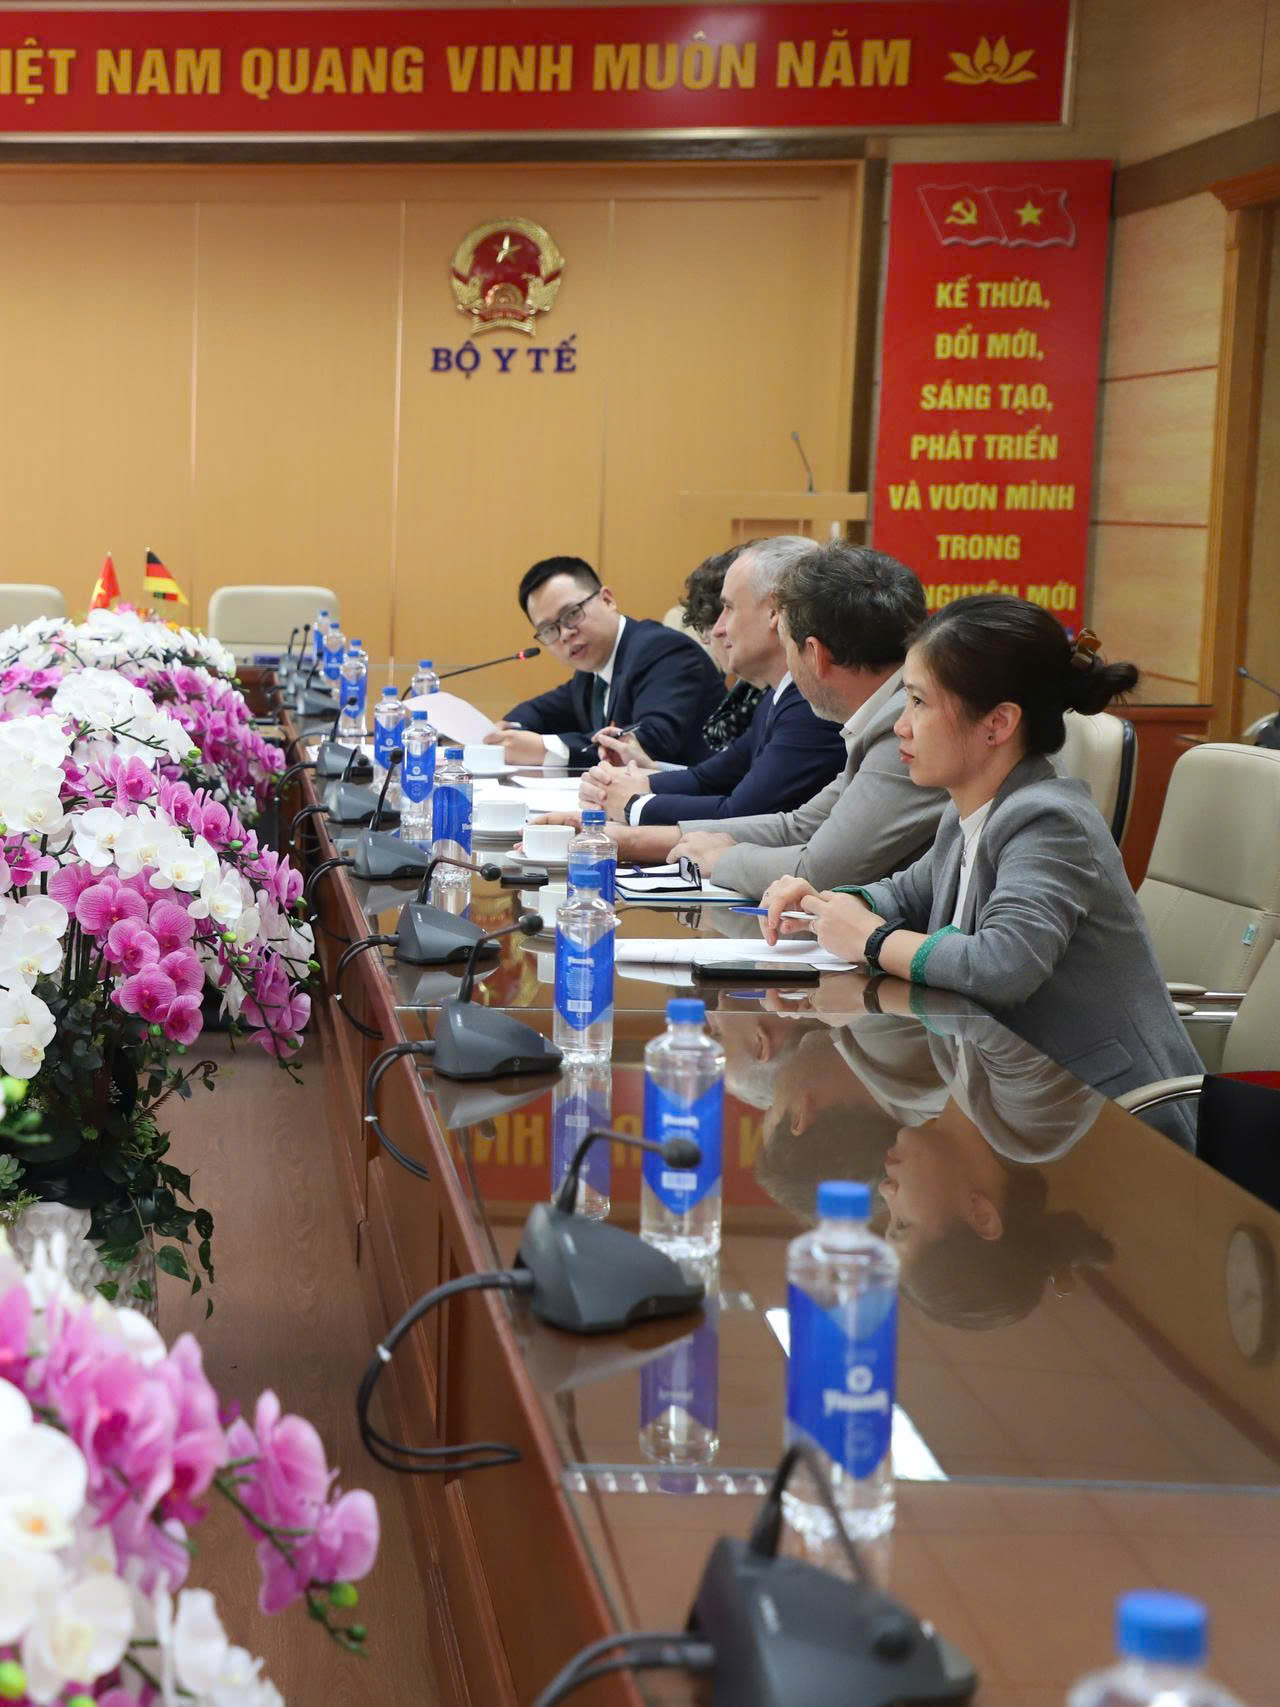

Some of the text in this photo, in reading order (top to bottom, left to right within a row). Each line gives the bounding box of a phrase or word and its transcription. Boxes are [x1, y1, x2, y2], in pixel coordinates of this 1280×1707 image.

[96, 48, 221, 95] NAM
[241, 47, 424, 100] QUANG
[447, 45, 573, 92] VINH
[593, 32, 757, 91] MUÔN
[776, 30, 910, 88] NĂM
[935, 273, 1050, 309] KẾ THỪA,
[430, 333, 577, 379] BỘ Y TẾ
[935, 324, 1045, 361] ĐỔI MỚI,
[919, 379, 1053, 415] SÁNG TẠO,
[910, 424, 1059, 461] PHÁT TRIỂN
[888, 480, 1076, 512] VÀ VƯƠN MÌNH
[935, 533, 1022, 560] TRONG
